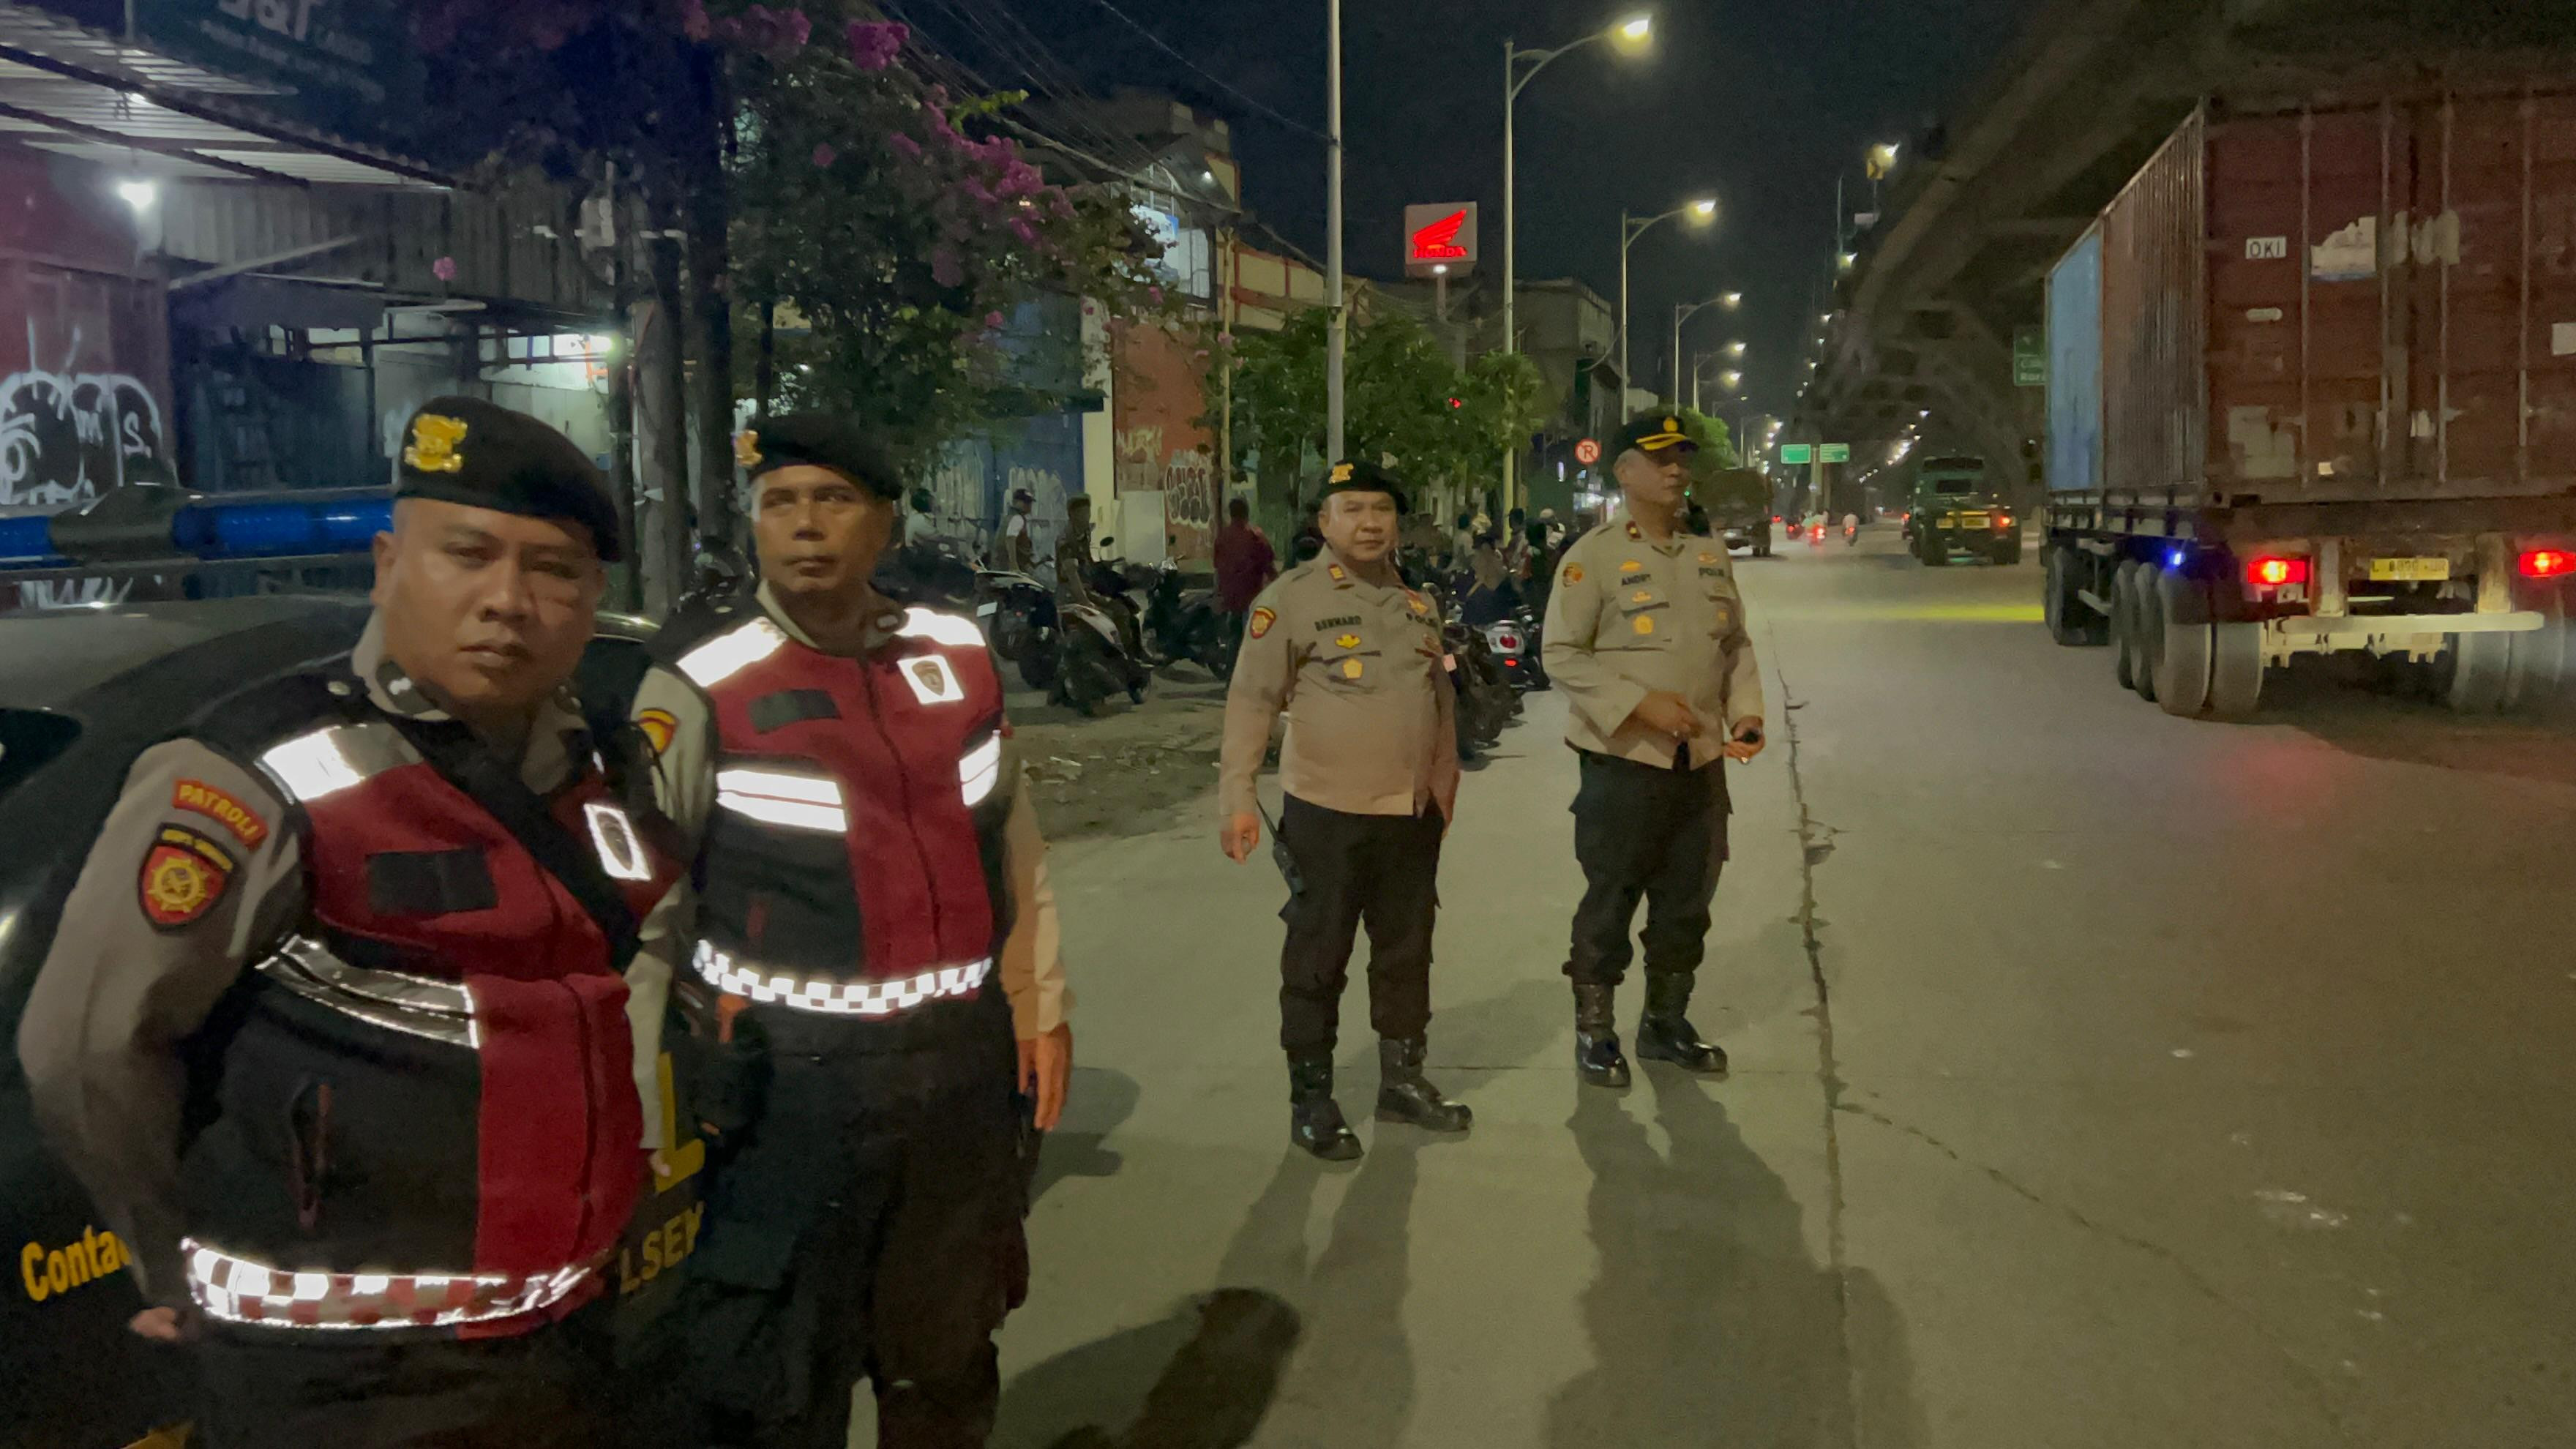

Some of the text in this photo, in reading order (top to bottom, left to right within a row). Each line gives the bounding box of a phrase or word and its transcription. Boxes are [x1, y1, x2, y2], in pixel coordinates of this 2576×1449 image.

[1414, 245, 1467, 258] HONDA
[2250, 240, 2280, 258] OKI
[179, 785, 258, 836] PATROLI
